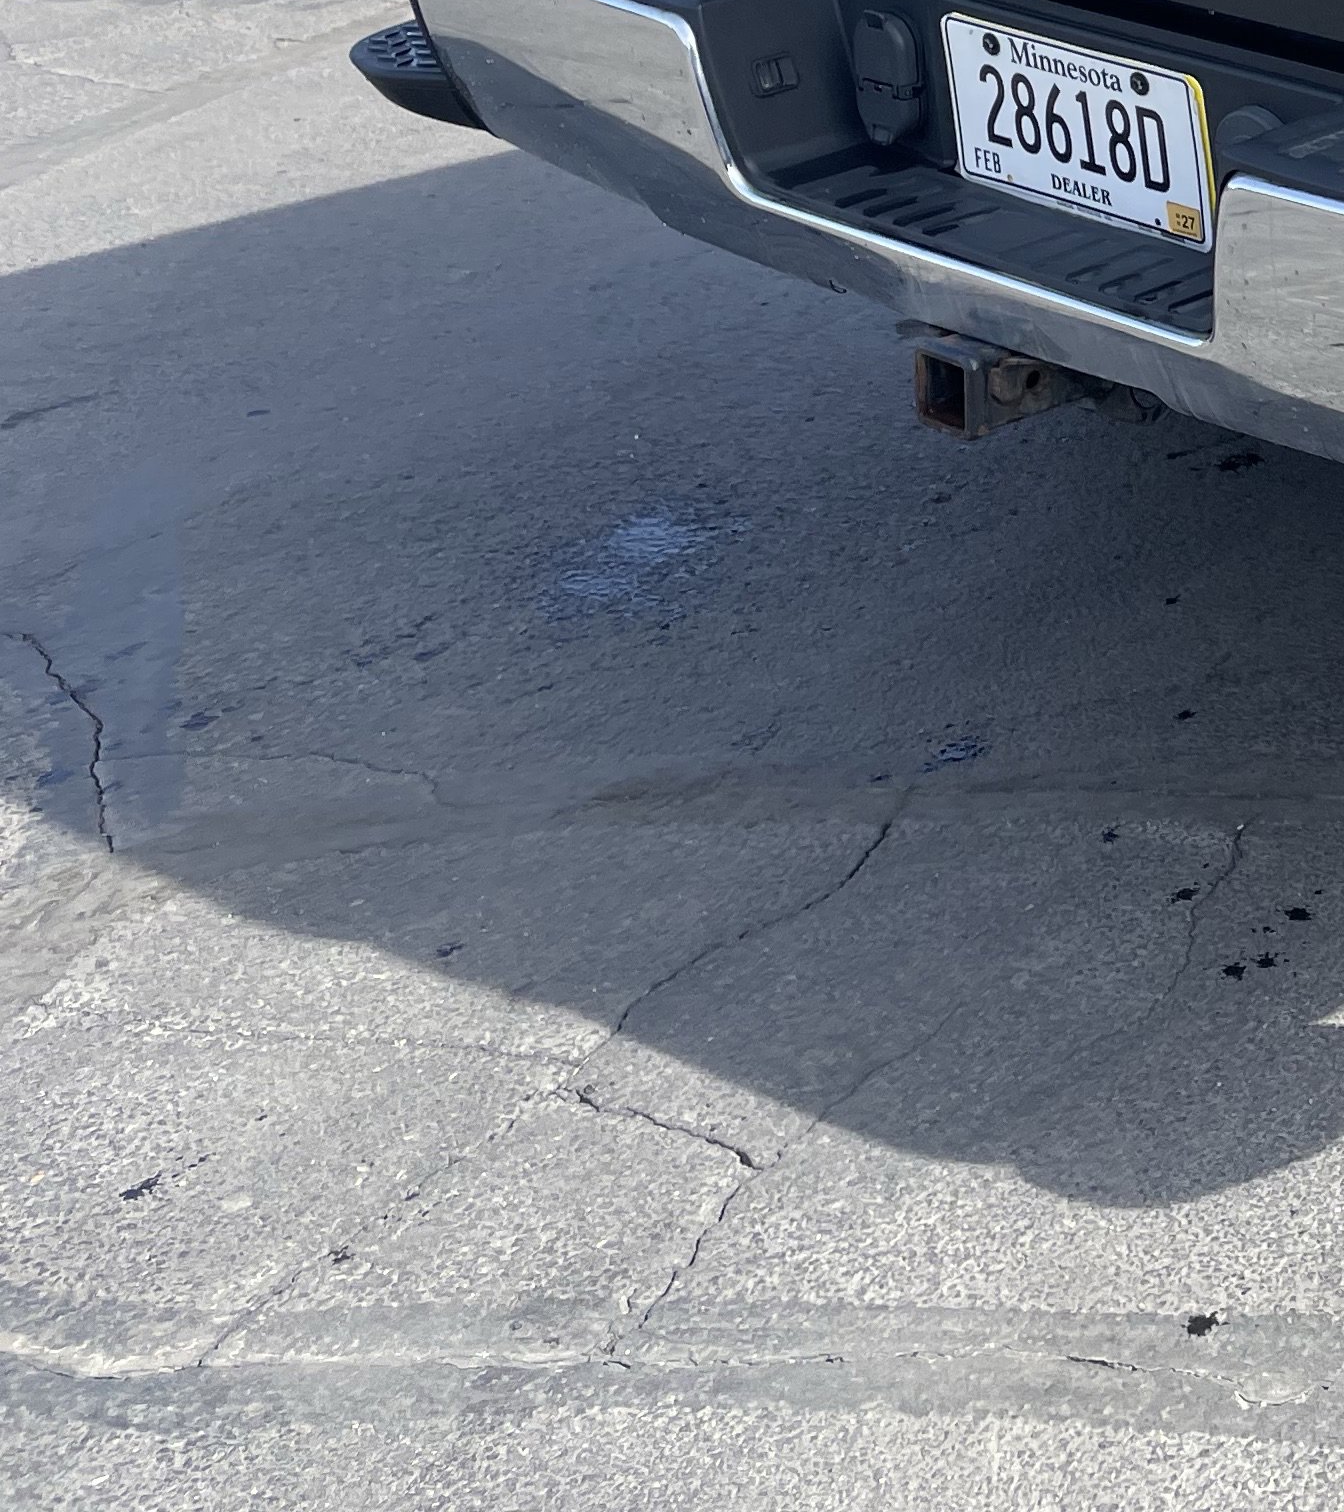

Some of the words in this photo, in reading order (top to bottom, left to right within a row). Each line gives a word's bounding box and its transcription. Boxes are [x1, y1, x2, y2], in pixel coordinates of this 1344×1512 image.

[1006, 37, 1123, 93] Minnesota
[979, 63, 1171, 193] 28618D
[974, 146, 1002, 175] FEB
[1050, 173, 1113, 207] DEALER
[1181, 214, 1195, 231] 27
